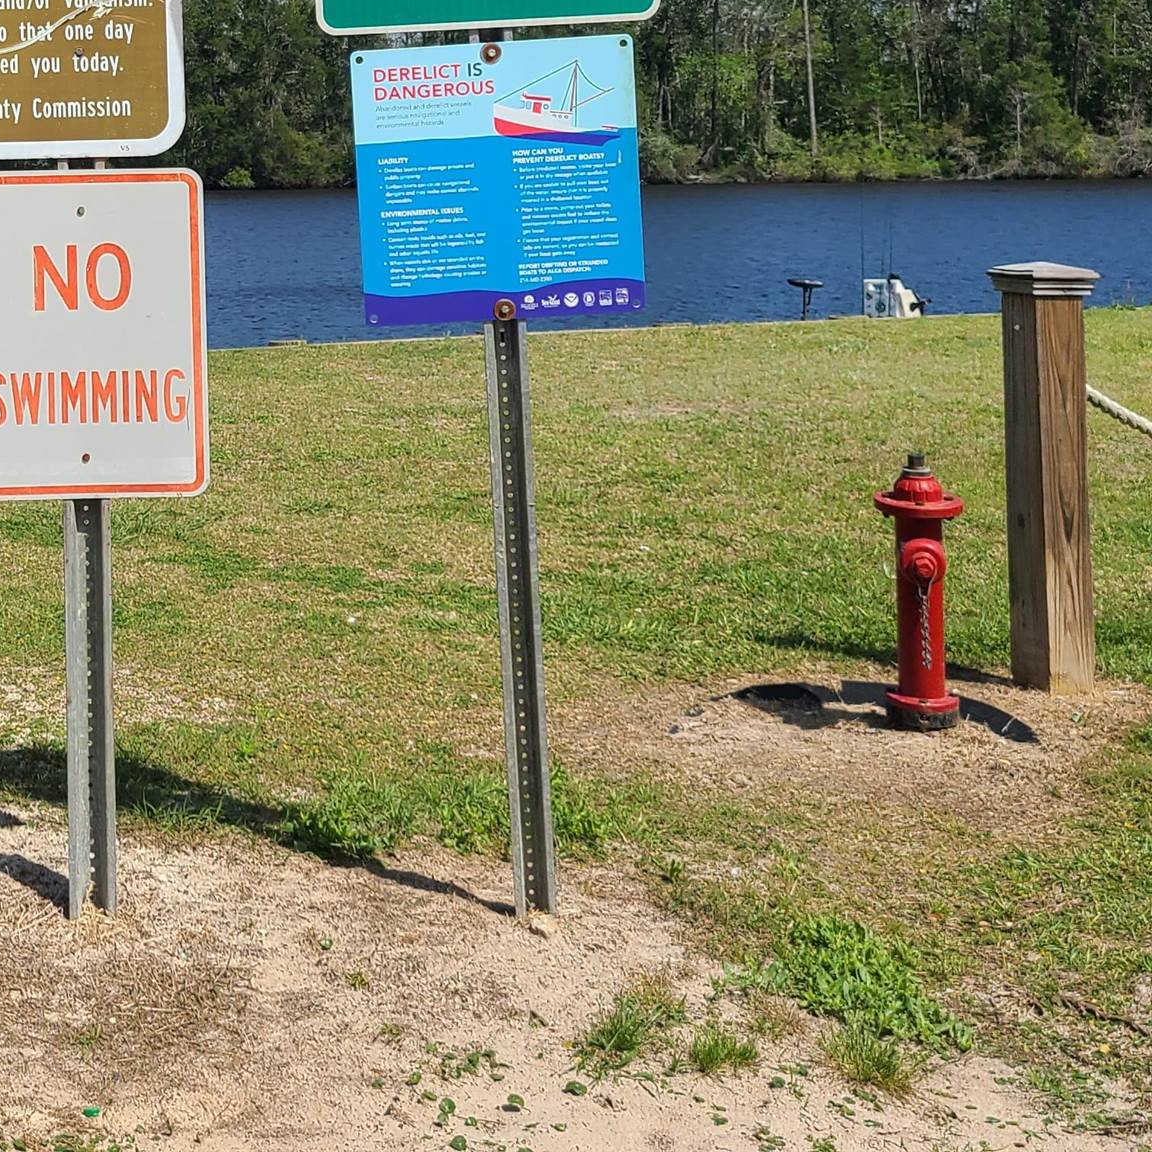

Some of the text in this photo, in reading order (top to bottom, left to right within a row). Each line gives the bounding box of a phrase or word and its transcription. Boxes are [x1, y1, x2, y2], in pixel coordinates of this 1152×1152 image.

[18, 21, 53, 42] that
[64, 24, 94, 41] one
[104, 19, 134, 45] day
[30, 56, 61, 79] you
[72, 51, 124, 77] today.
[374, 62, 483, 83] DERELICT IS
[374, 80, 495, 101] DANGEROUS
[32, 96, 131, 119] Commission
[33, 242, 131, 311] NO
